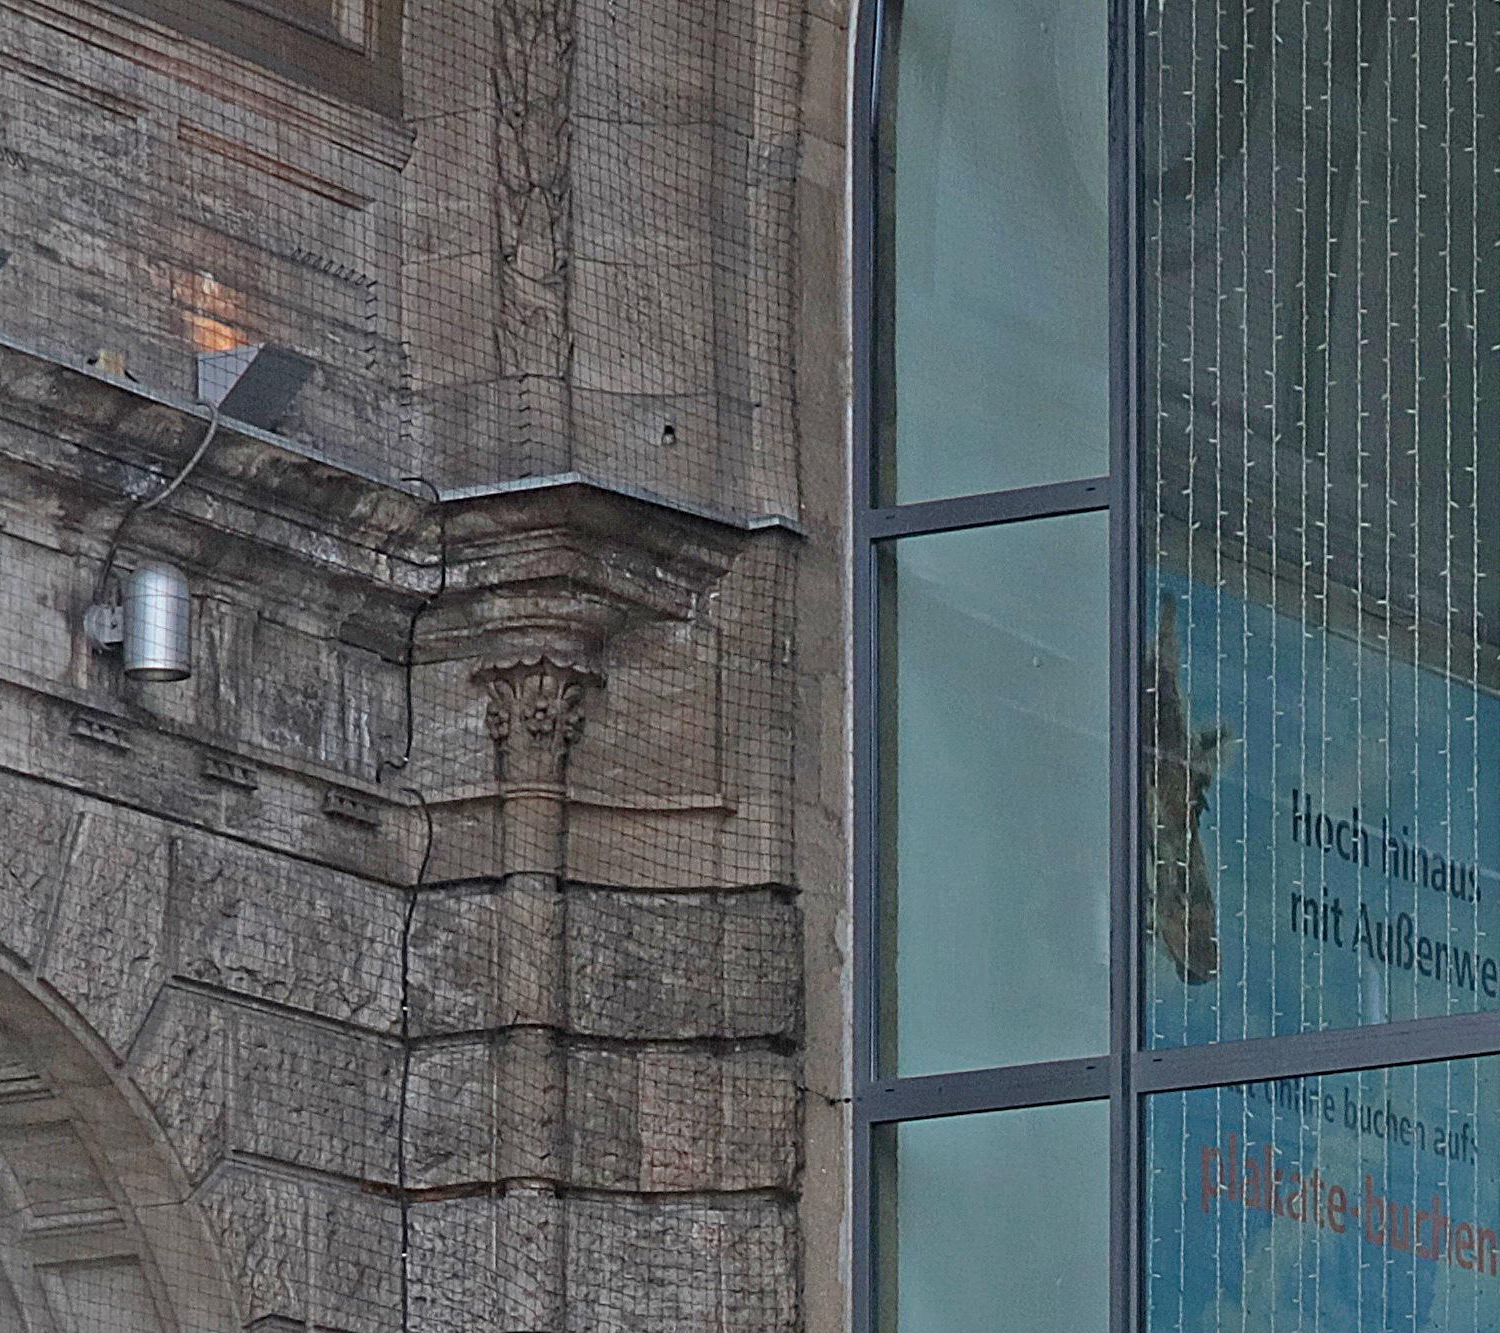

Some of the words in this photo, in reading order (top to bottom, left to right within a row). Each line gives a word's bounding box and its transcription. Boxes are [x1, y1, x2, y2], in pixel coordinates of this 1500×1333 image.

[1292, 789, 1371, 868] Hoch
[1381, 817, 1481, 903] hinaus
[1291, 886, 1343, 948] mit
[1343, 1088, 1427, 1152] buchen
[1433, 1121, 1480, 1164] auf:
